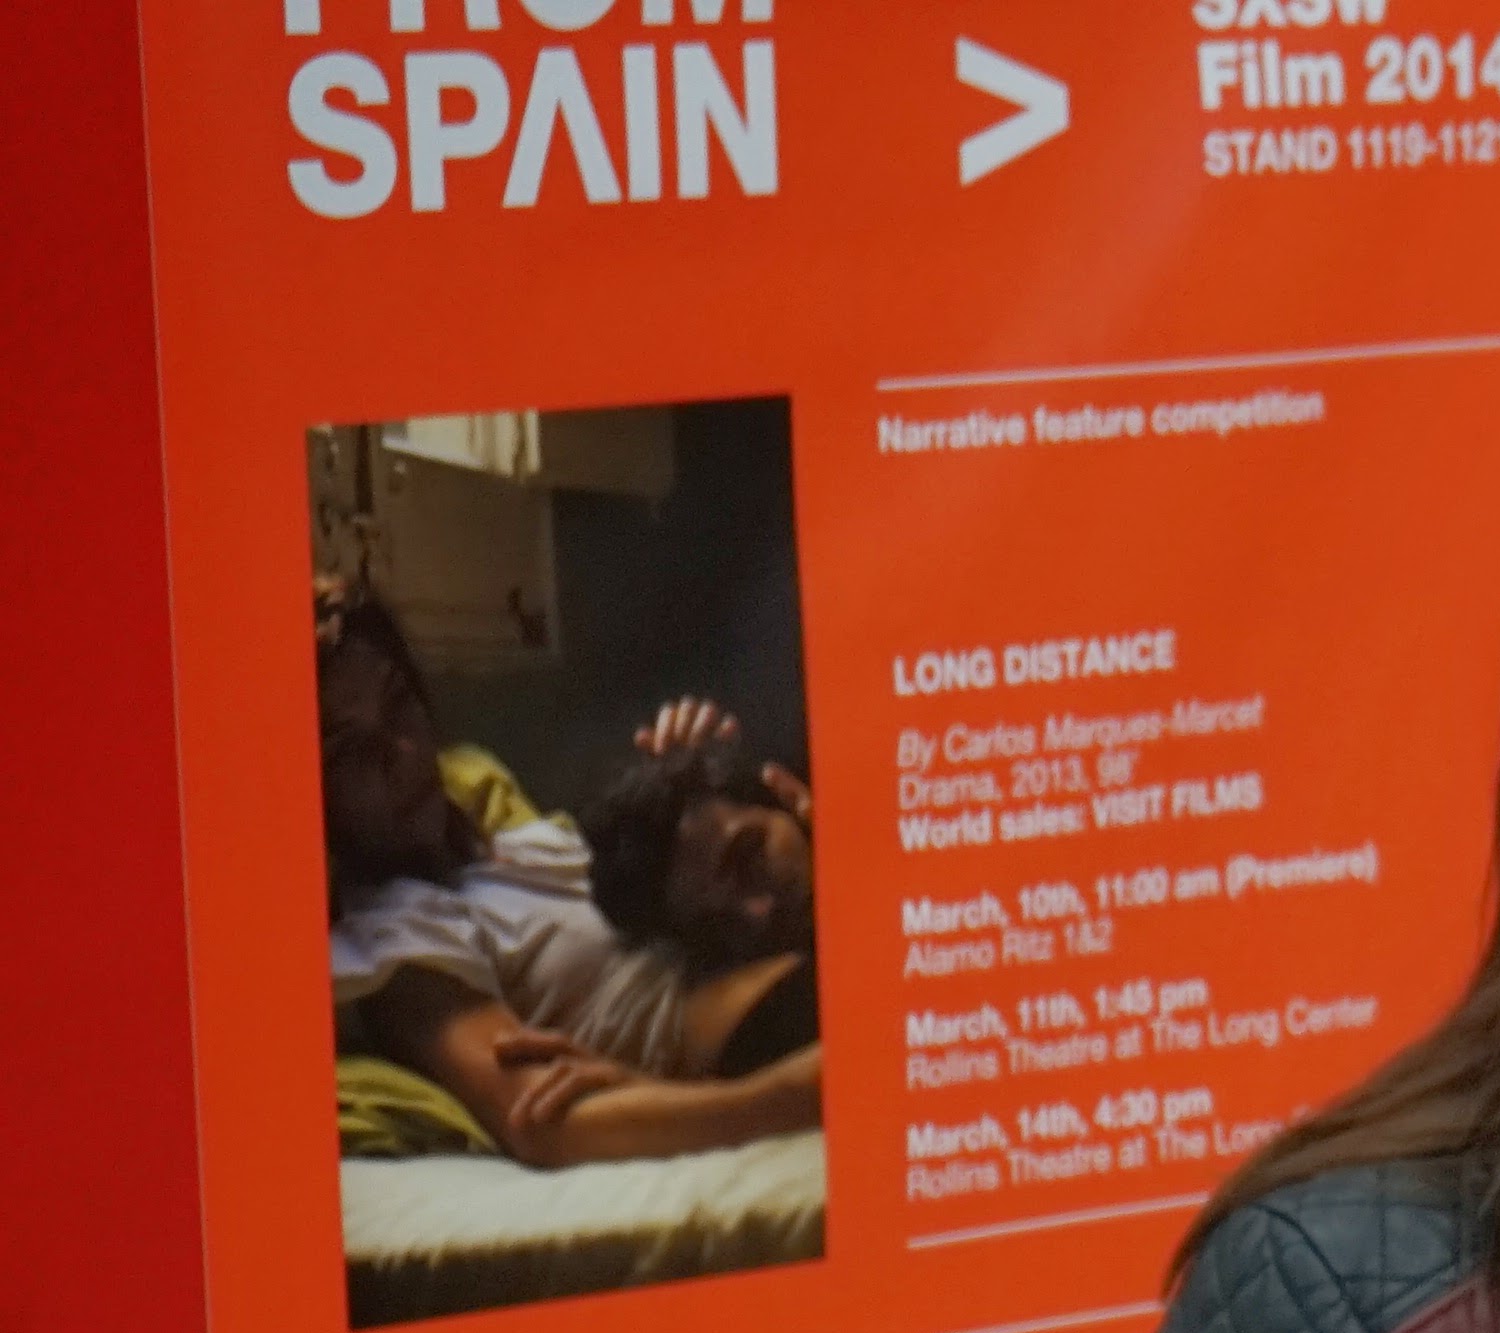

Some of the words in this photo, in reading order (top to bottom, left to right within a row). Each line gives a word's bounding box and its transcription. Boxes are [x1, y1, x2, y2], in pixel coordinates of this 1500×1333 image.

[1197, 38, 1346, 110] Film
[287, 41, 778, 219] SPAIN
[1203, 125, 1339, 177] STAND
[878, 408, 1025, 454] Narrative
[1033, 404, 1144, 443] feature
[1152, 387, 1324, 439] competition
[893, 646, 996, 697] LONG
[1003, 629, 1176, 687] DISTANCE
[898, 727, 938, 772] By
[943, 722, 1037, 764] Carlos
[899, 807, 994, 851] World
[999, 802, 1085, 842] sales:
[1092, 783, 1167, 829] VISIT
[1171, 771, 1264, 819] FILMS
[902, 890, 1010, 936] March,
[1095, 867, 1169, 910] 11:00
[1174, 867, 1221, 900] am
[1225, 840, 1379, 902] (Premiere)
[905, 1002, 1009, 1048] March,
[1159, 977, 1210, 1014] pm
[1006, 1032, 1108, 1075] Theatre
[1114, 1023, 1144, 1061] at
[1151, 1016, 1202, 1052] The
[1208, 1007, 1281, 1049] Long
[1284, 993, 1379, 1038] Center
[907, 1113, 1008, 1160] March,
[1162, 1085, 1214, 1124] pm
[1007, 1143, 1113, 1186] Theatre
[1118, 1135, 1147, 1170] at
[1155, 1125, 1209, 1163] The
